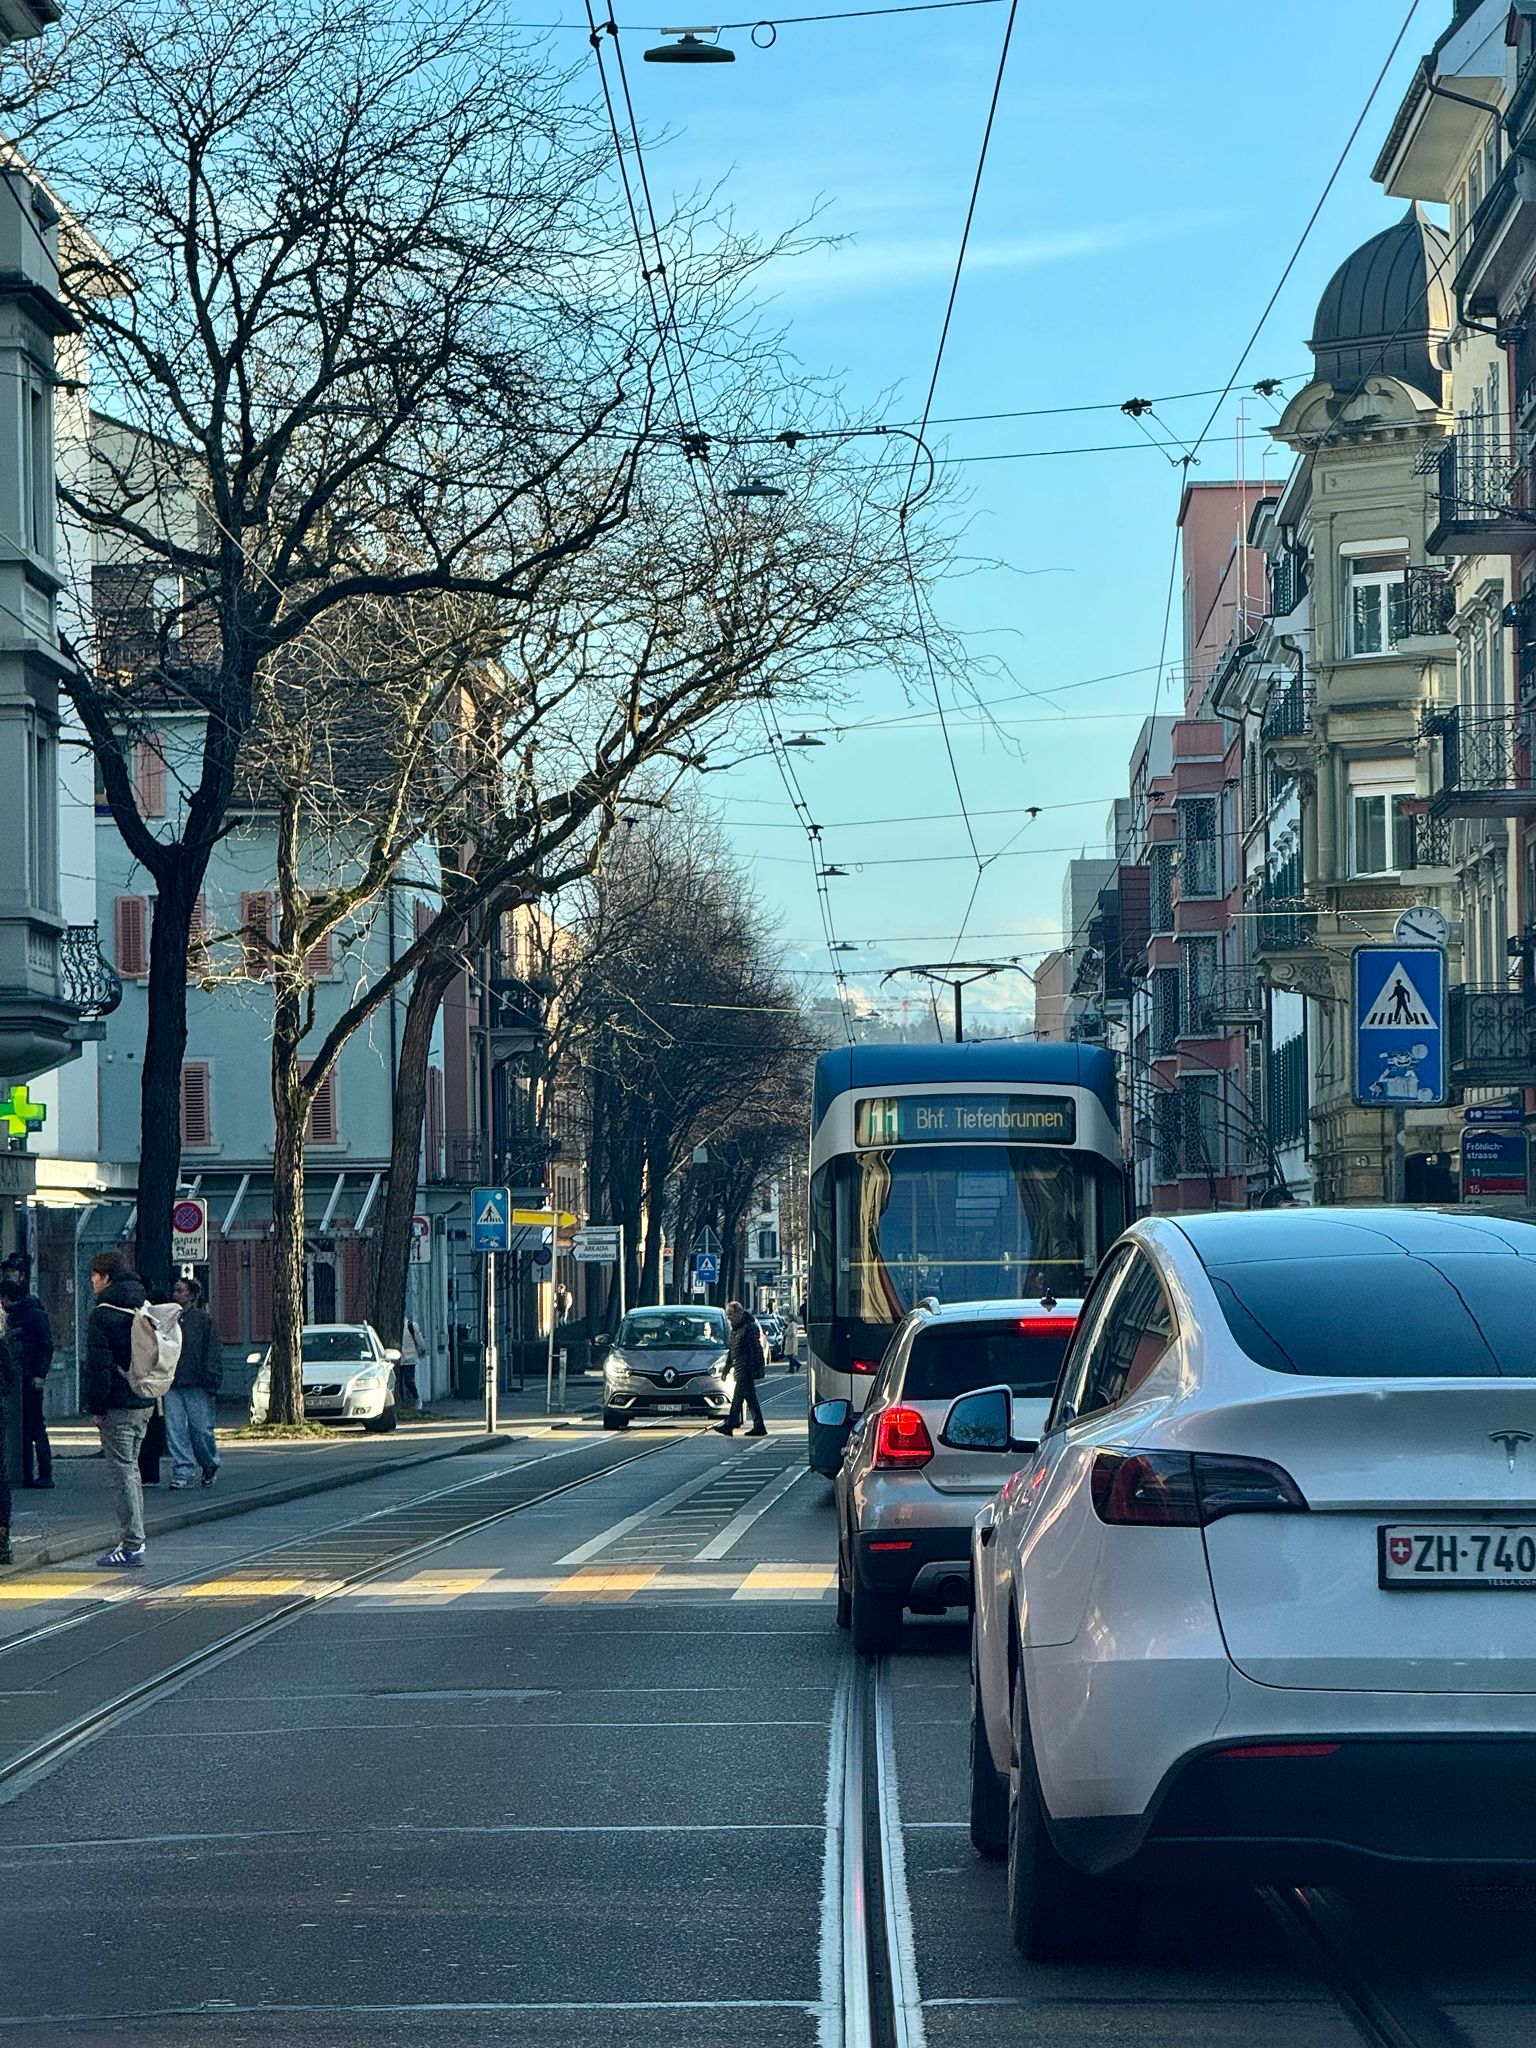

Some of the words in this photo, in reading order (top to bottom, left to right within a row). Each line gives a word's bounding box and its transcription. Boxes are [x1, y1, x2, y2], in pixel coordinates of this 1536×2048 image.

[872, 1104, 898, 1131] 11
[916, 1107, 948, 1129] Bhf.
[954, 1106, 1064, 1128] Tiefenbrunnen
[1465, 1142, 1503, 1151] Fröhlich-
[1471, 1168, 1481, 1177] 11
[1470, 1185, 1480, 1194] 15
